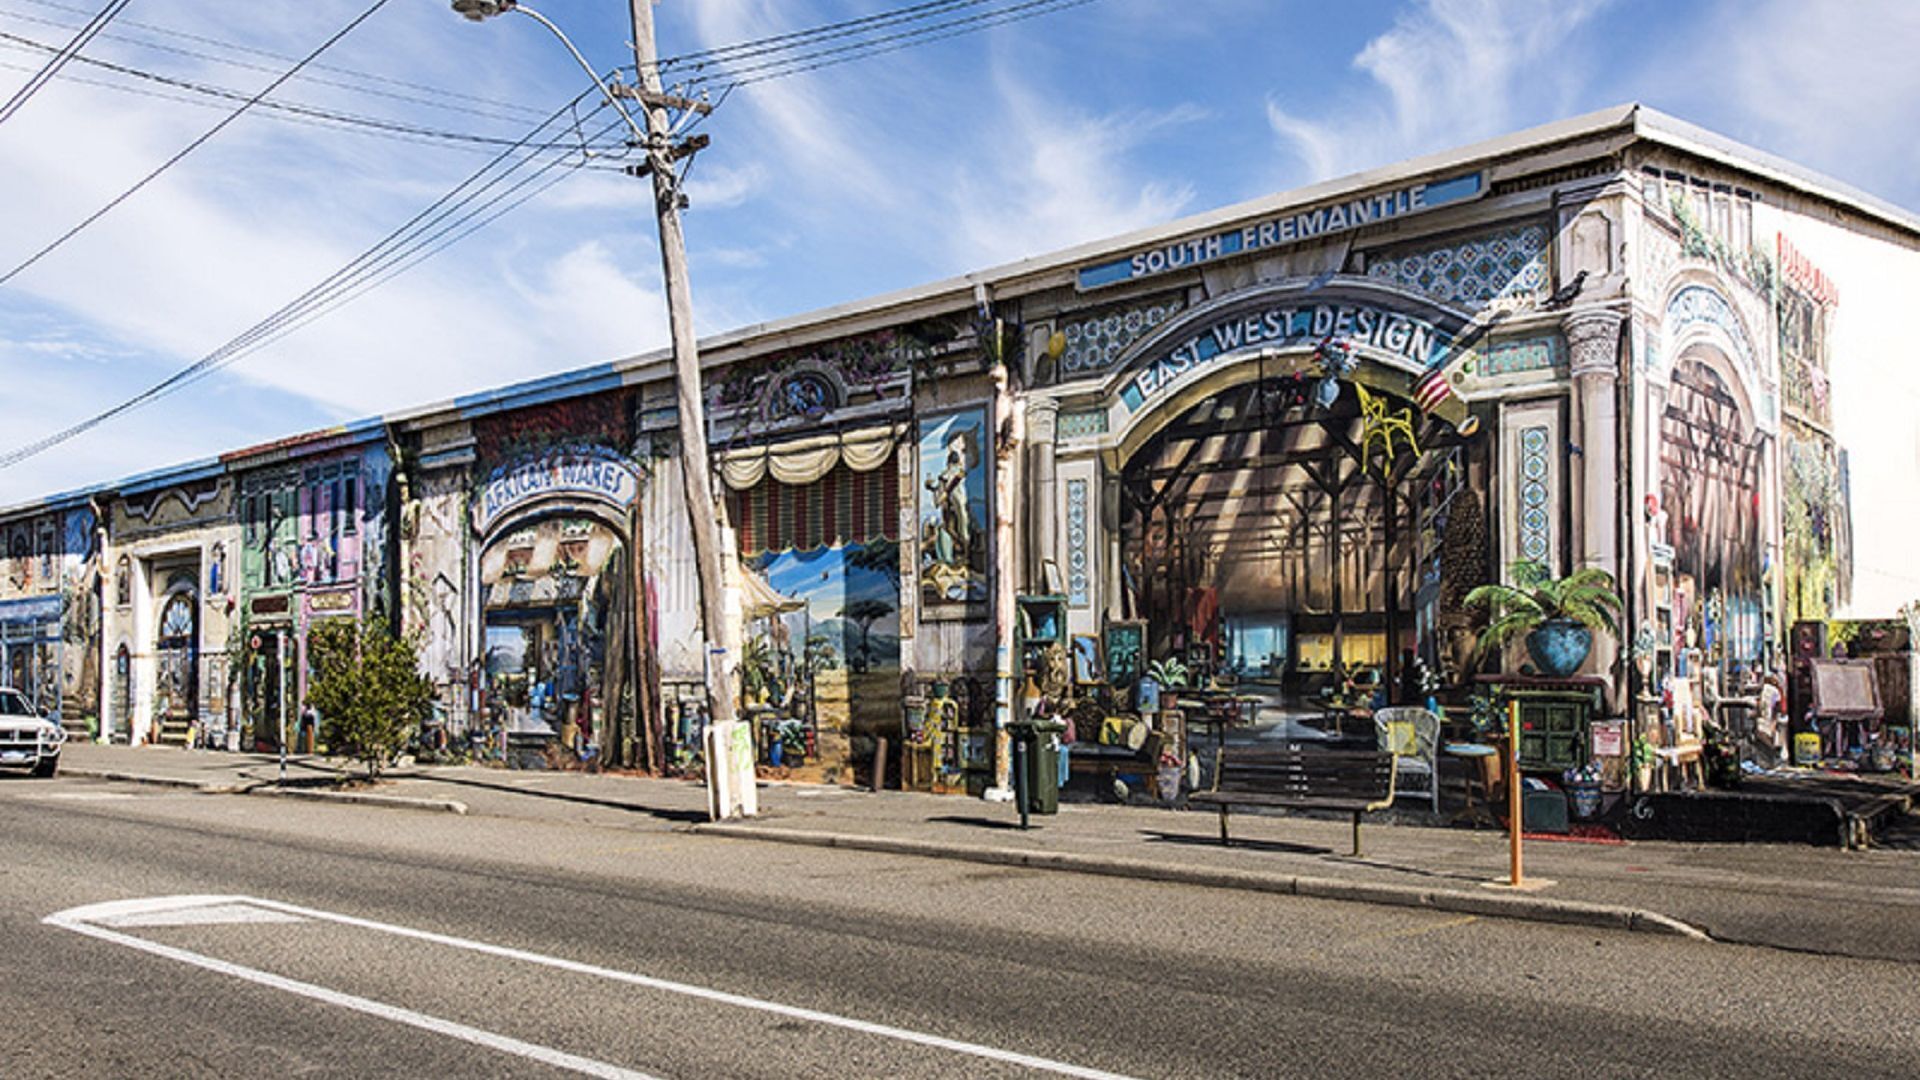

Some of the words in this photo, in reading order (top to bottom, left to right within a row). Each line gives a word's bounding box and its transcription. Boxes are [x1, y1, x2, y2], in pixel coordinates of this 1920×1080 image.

[1131, 235, 1223, 278] SOUTH
[1242, 185, 1427, 250] FREMANTLE
[1136, 338, 1202, 397] EAST
[1212, 312, 1297, 351] WEST
[1313, 305, 1436, 367] DESIGN
[485, 463, 552, 518] AFRICAN
[561, 463, 625, 494] WARES
